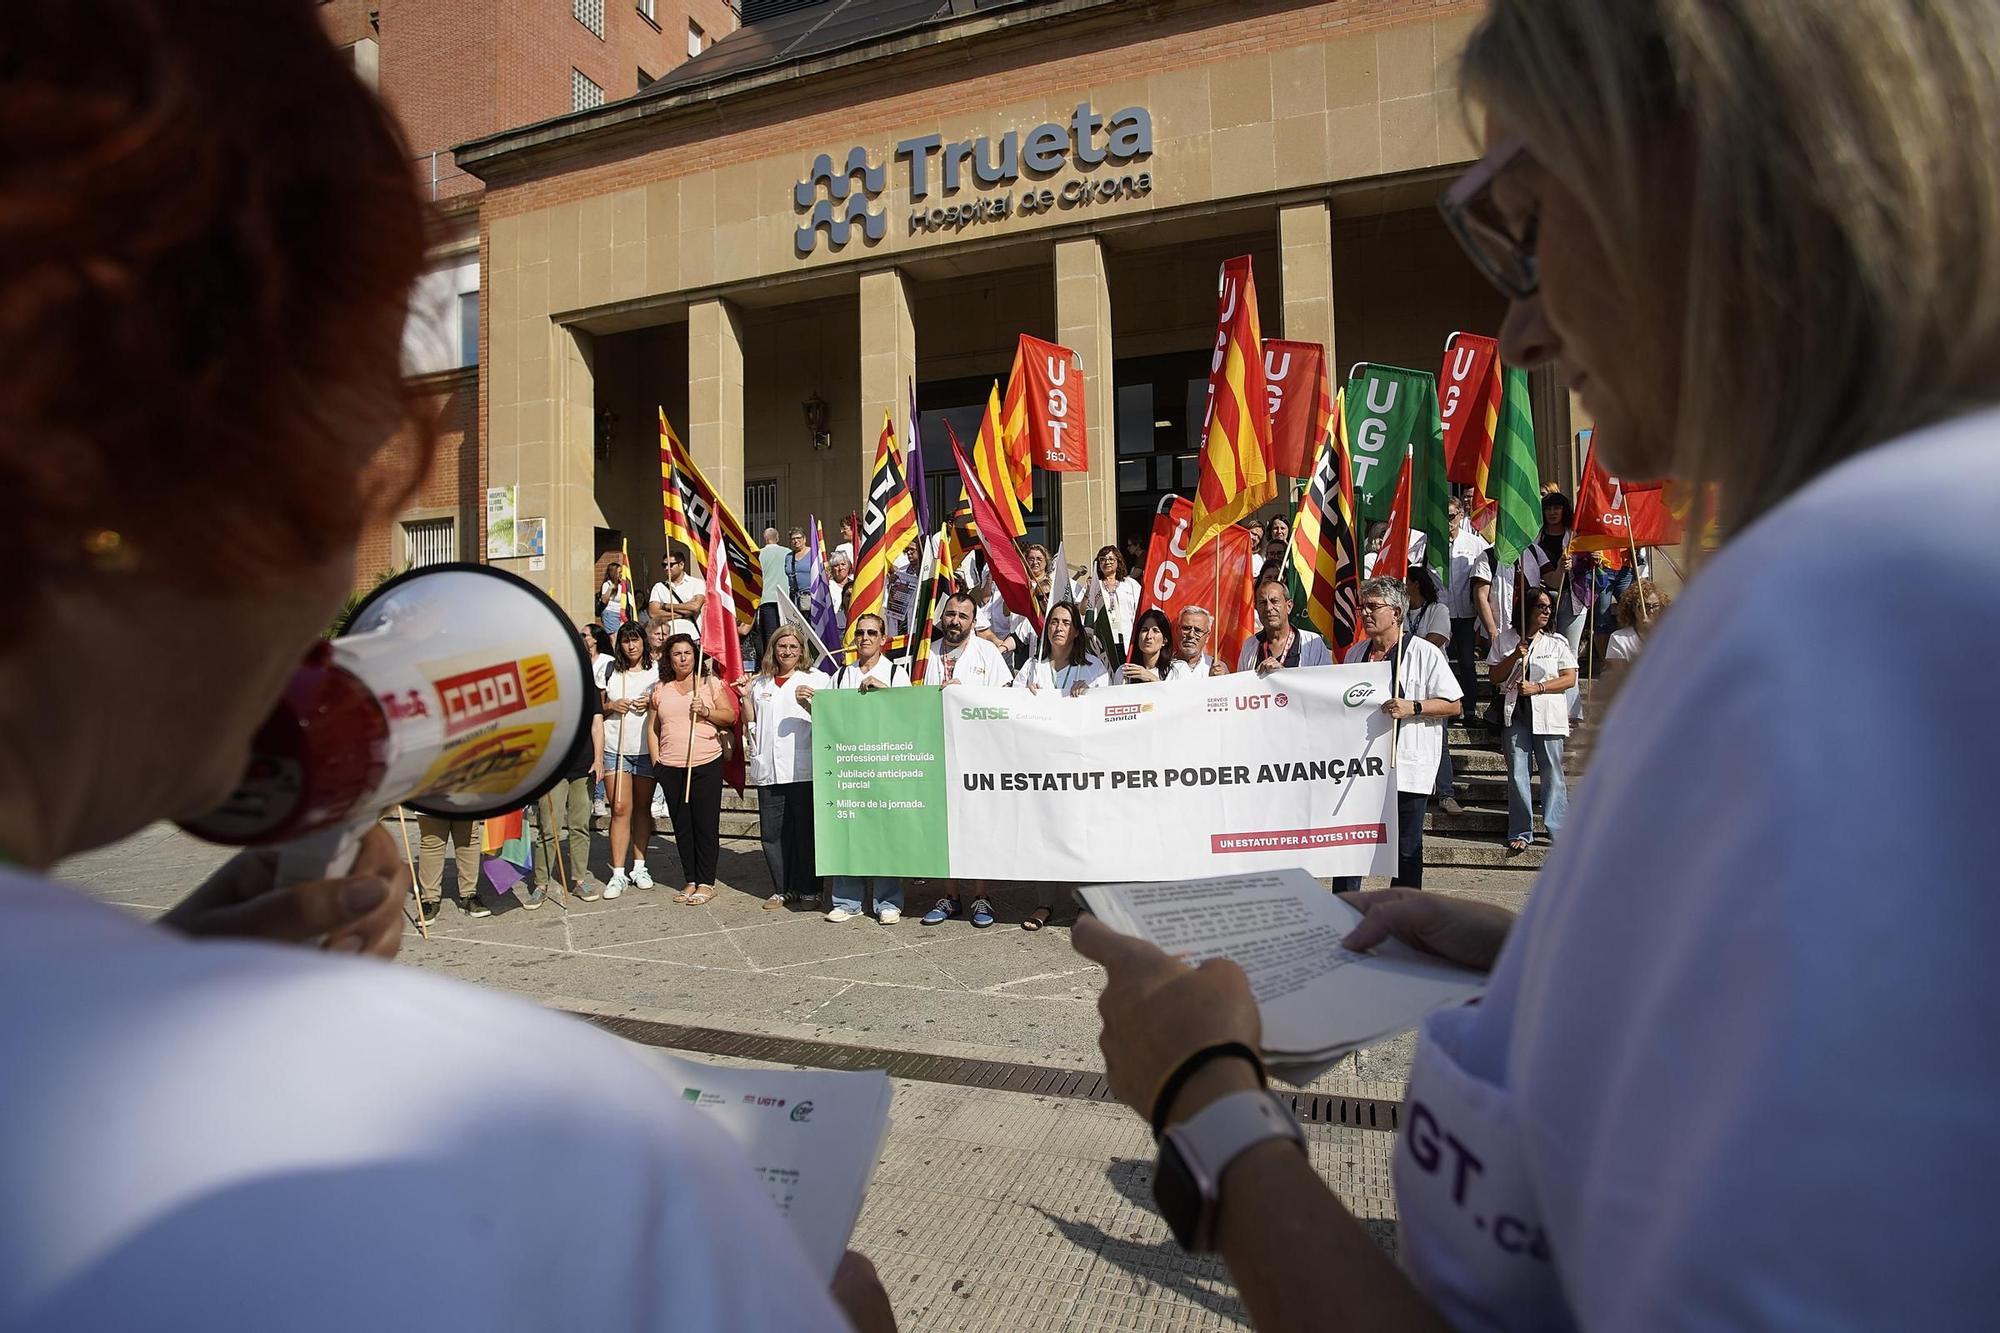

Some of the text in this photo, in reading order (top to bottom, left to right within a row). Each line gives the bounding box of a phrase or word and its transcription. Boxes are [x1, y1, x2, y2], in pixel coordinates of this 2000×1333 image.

[898, 101, 1153, 196] Trueta
[911, 189, 1013, 229] Hospital
[1021, 186, 1055, 209] de
[1264, 351, 1291, 424] UG
[1353, 378, 1398, 487] UGT
[443, 672, 519, 724] CCOO
[1349, 688, 1377, 698] CSIF
[1235, 694, 1272, 710] UGT
[960, 707, 1010, 721] SATSE
[1106, 706, 1140, 715] CCOO
[1104, 713, 1138, 723] sanitat
[835, 741, 914, 752] Nova classificació
[836, 752, 935, 764] professional retribuïda
[837, 769, 924, 780] Jubilació anticipada
[963, 756, 1385, 792] UN ESTATUT PER PODER AVANÇAR
[842, 781, 871, 791] parcial
[836, 799, 926, 811] Millora de la jornada.
[837, 810, 856, 819] 35 h
[1220, 839, 1235, 848] UN
[1236, 837, 1279, 847] ESTATUT
[1280, 836, 1299, 846] PER
[1301, 835, 1309, 844] A
[1310, 832, 1344, 843] TOTES
[1351, 830, 1379, 840] TOTS
